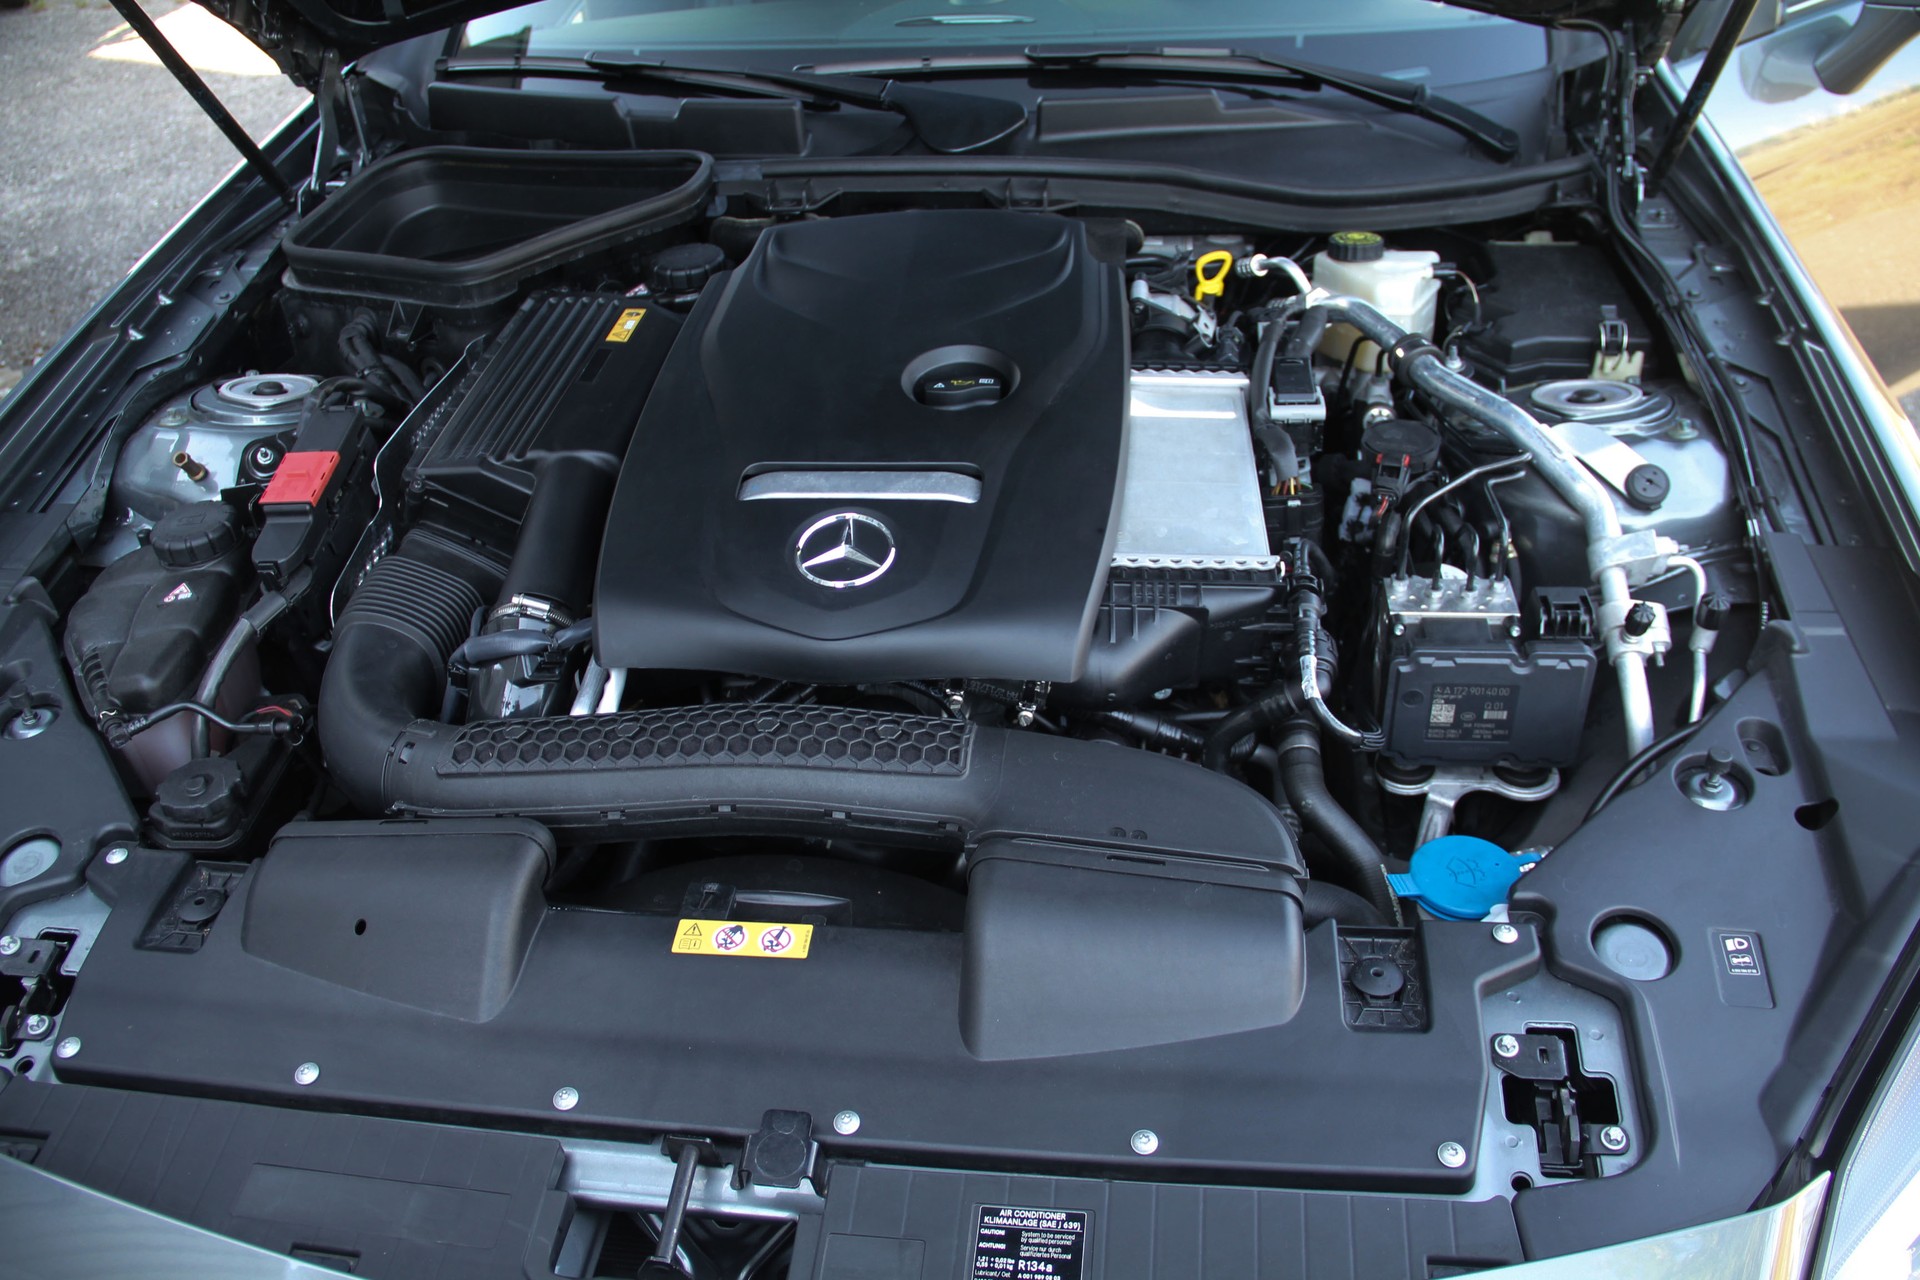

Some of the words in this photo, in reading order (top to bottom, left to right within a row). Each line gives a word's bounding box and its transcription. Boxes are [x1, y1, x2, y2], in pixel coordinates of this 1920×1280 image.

[1444, 686, 1450, 694] A
[1453, 686, 1468, 696] 172
[1000, 1208, 1012, 1216] AIR
[1014, 1210, 1066, 1220] CONDITIONER
[984, 1216, 1038, 1227] KLIMAANLAGE
[1040, 1220, 1057, 1229] (SAE
[1063, 1222, 1080, 1230] 639)
[1018, 1259, 1053, 1273] R134a
